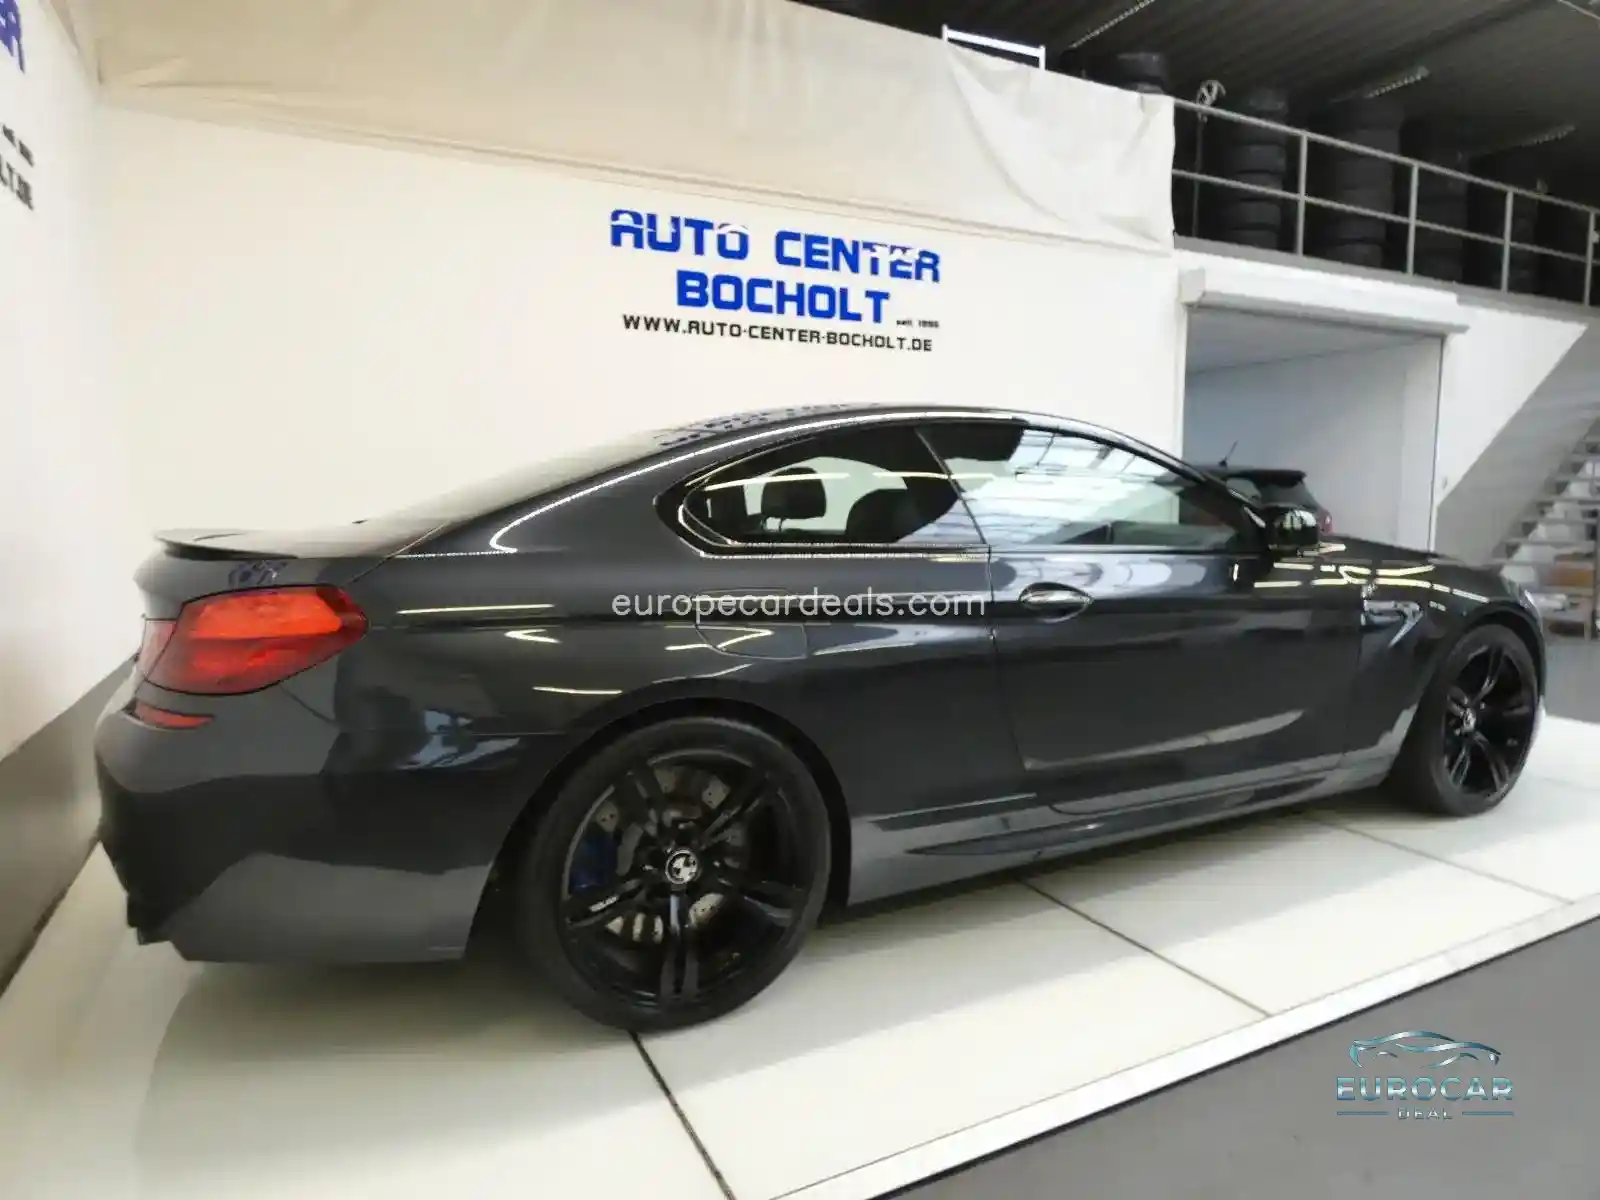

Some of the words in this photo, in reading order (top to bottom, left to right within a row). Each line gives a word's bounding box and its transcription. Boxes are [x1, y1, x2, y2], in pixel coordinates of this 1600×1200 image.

[610, 209, 749, 261] AUTO
[774, 230, 941, 283] CENTER
[676, 269, 890, 324] BOCHOLT
